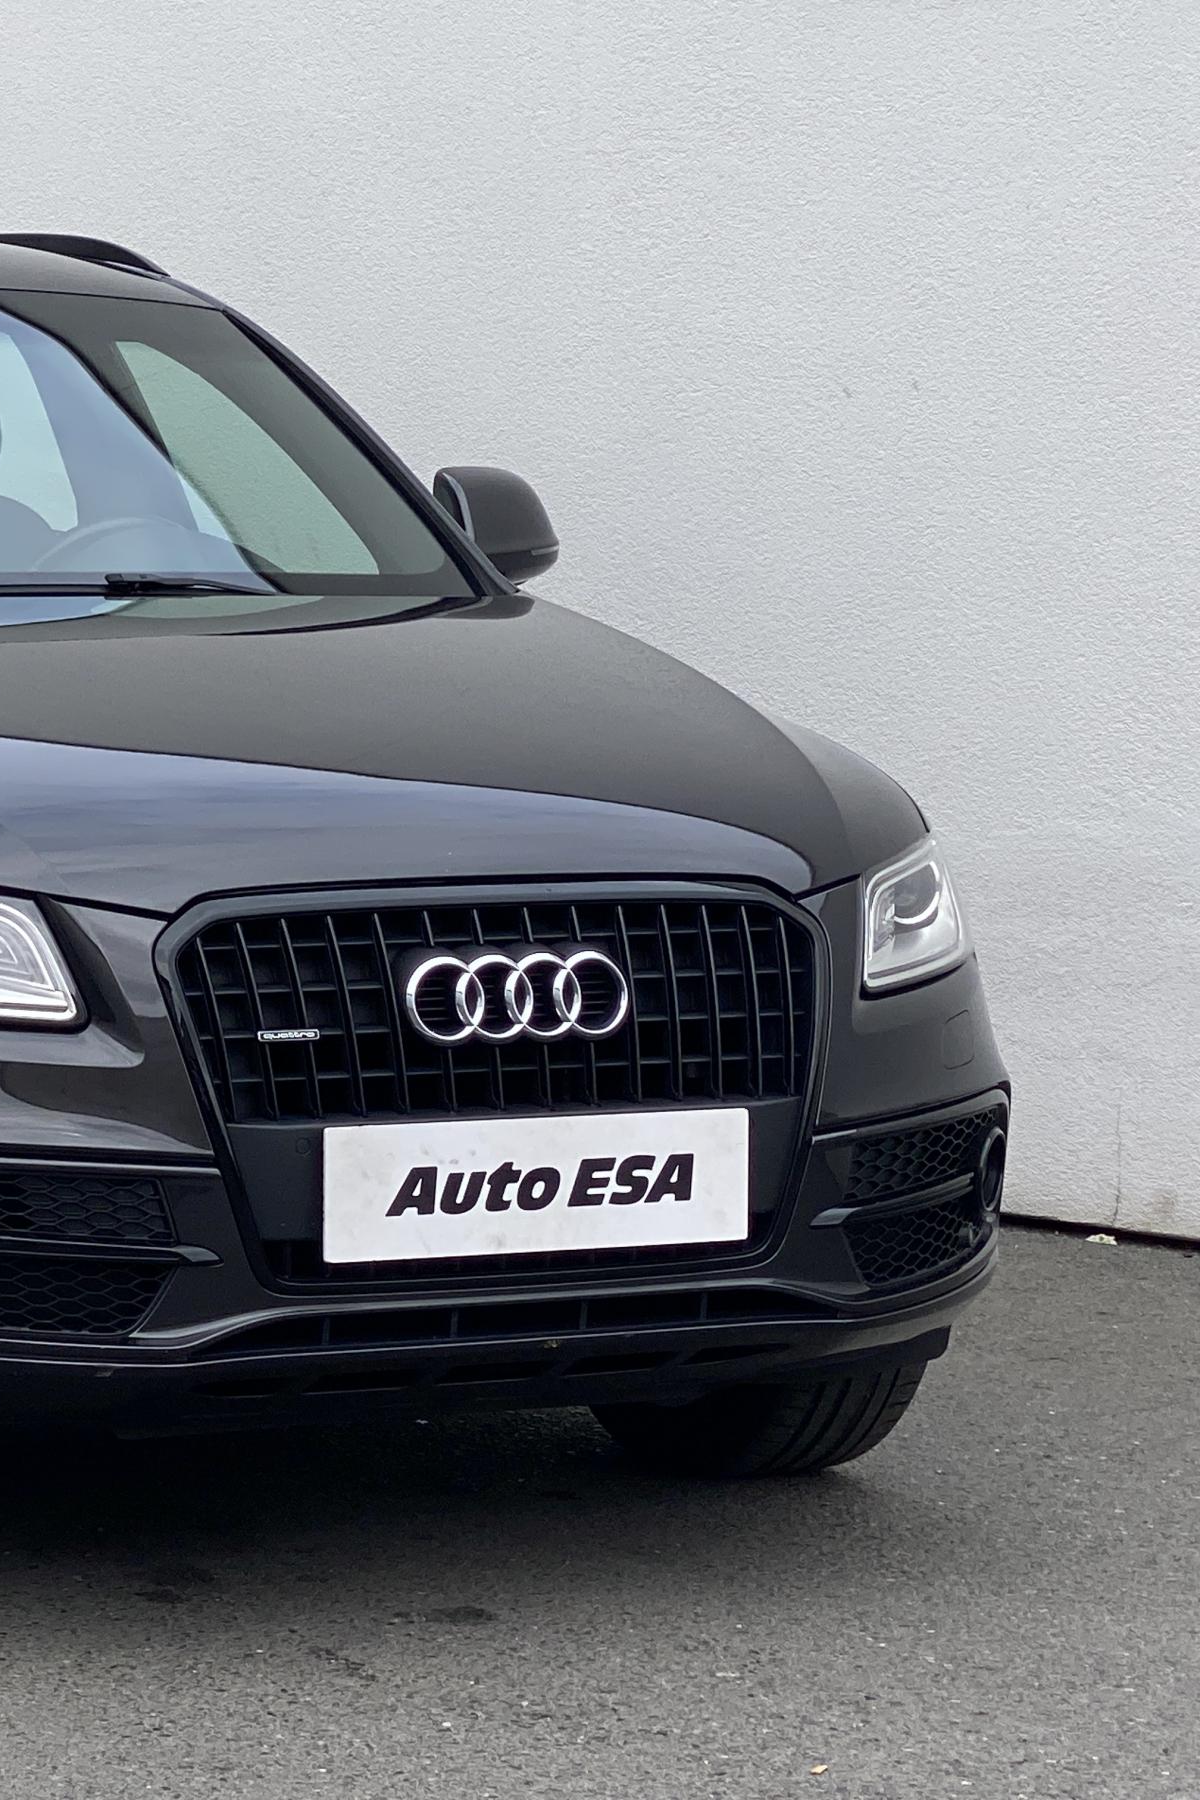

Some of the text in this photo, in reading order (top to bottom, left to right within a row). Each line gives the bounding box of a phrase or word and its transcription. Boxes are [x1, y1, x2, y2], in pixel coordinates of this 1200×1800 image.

[262, 1031, 316, 1040] quattro
[385, 1153, 695, 1217] Auto ESA
